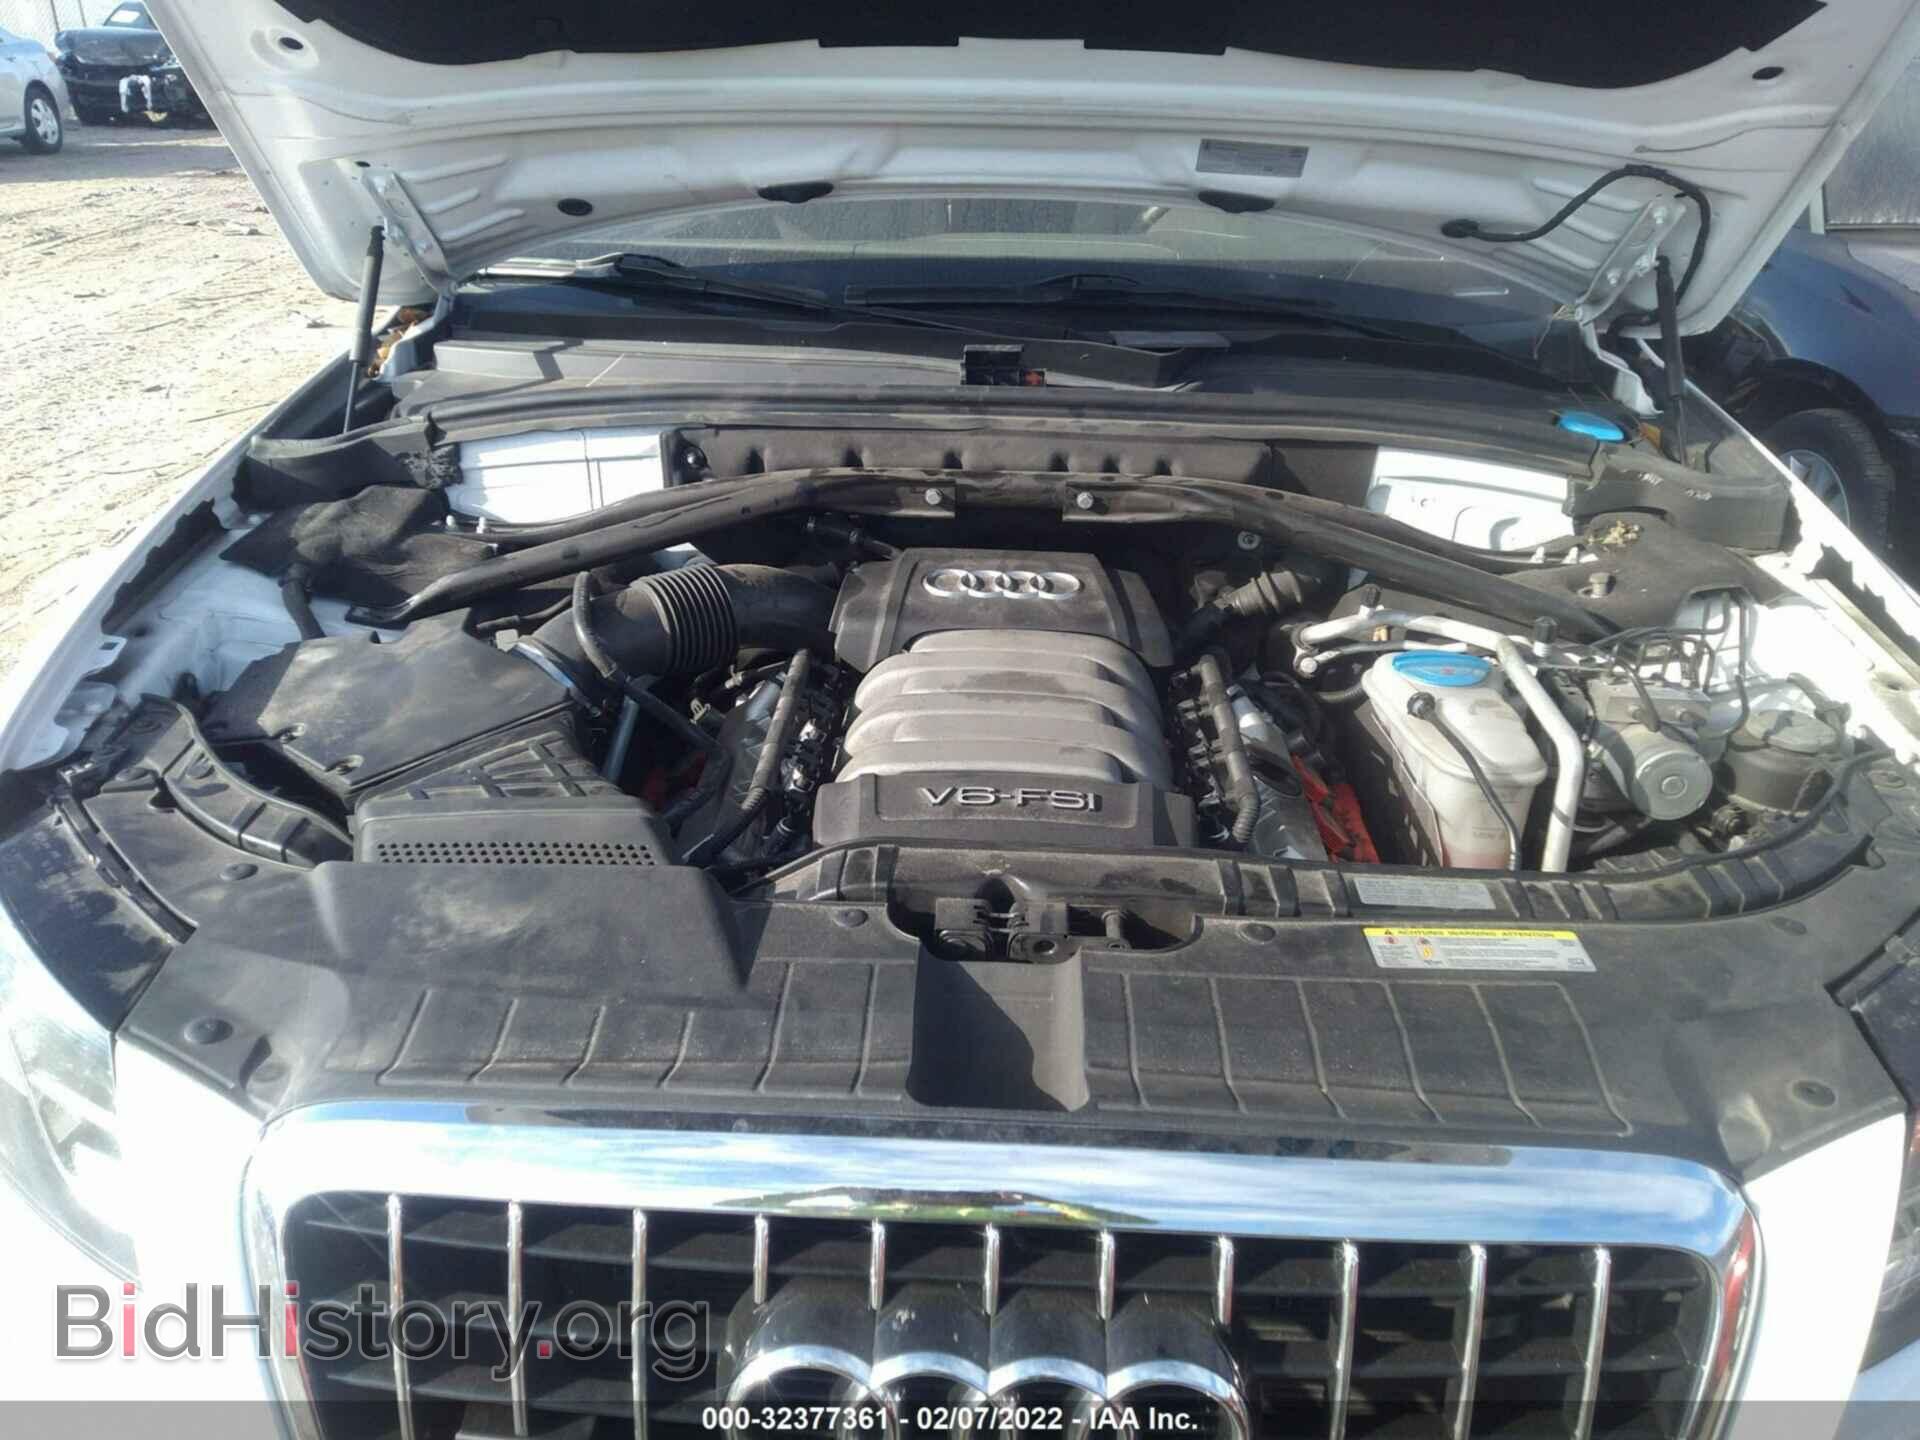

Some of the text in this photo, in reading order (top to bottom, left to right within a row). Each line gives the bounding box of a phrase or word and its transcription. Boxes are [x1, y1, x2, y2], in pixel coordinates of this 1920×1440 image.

[920, 786, 1098, 811] V6-FSI
[1448, 930, 1496, 938] WARNING
[1501, 931, 1555, 939] ATTENTION
